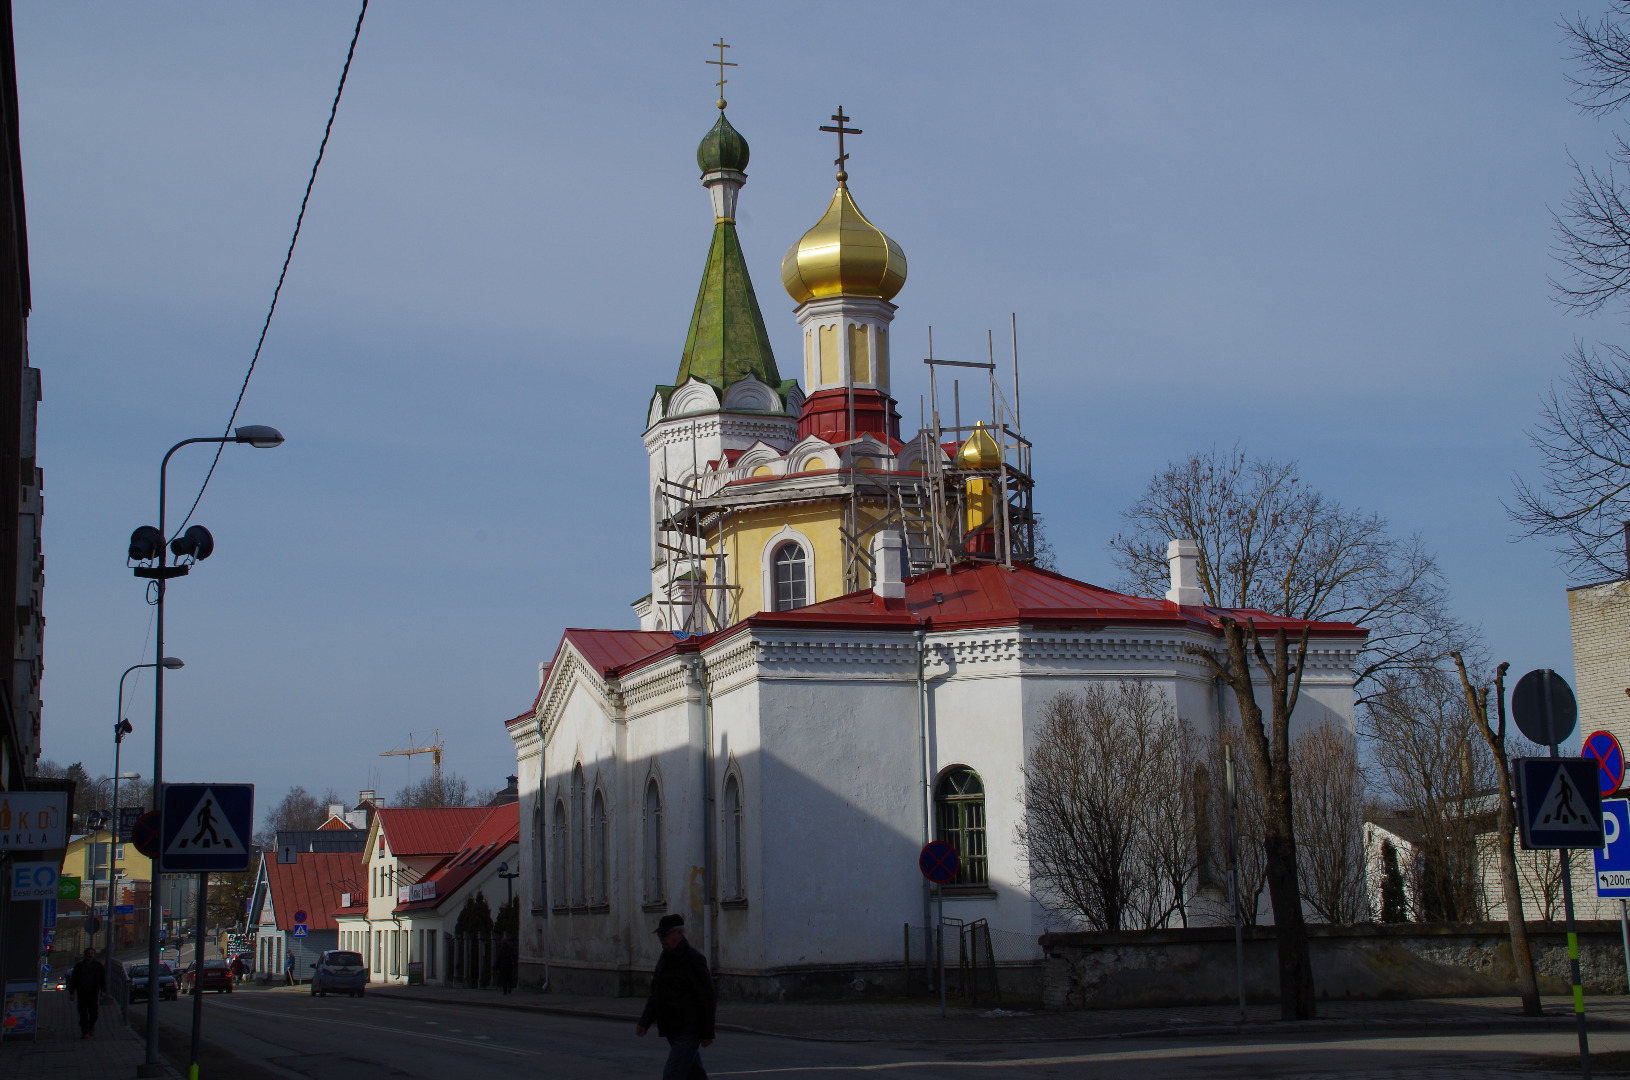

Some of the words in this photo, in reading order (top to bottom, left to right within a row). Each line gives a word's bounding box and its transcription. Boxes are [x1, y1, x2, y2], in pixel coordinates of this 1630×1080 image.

[1602, 811, 1620, 860] P
[13, 889, 32, 897] Eesti
[33, 888, 55, 896] Optik
